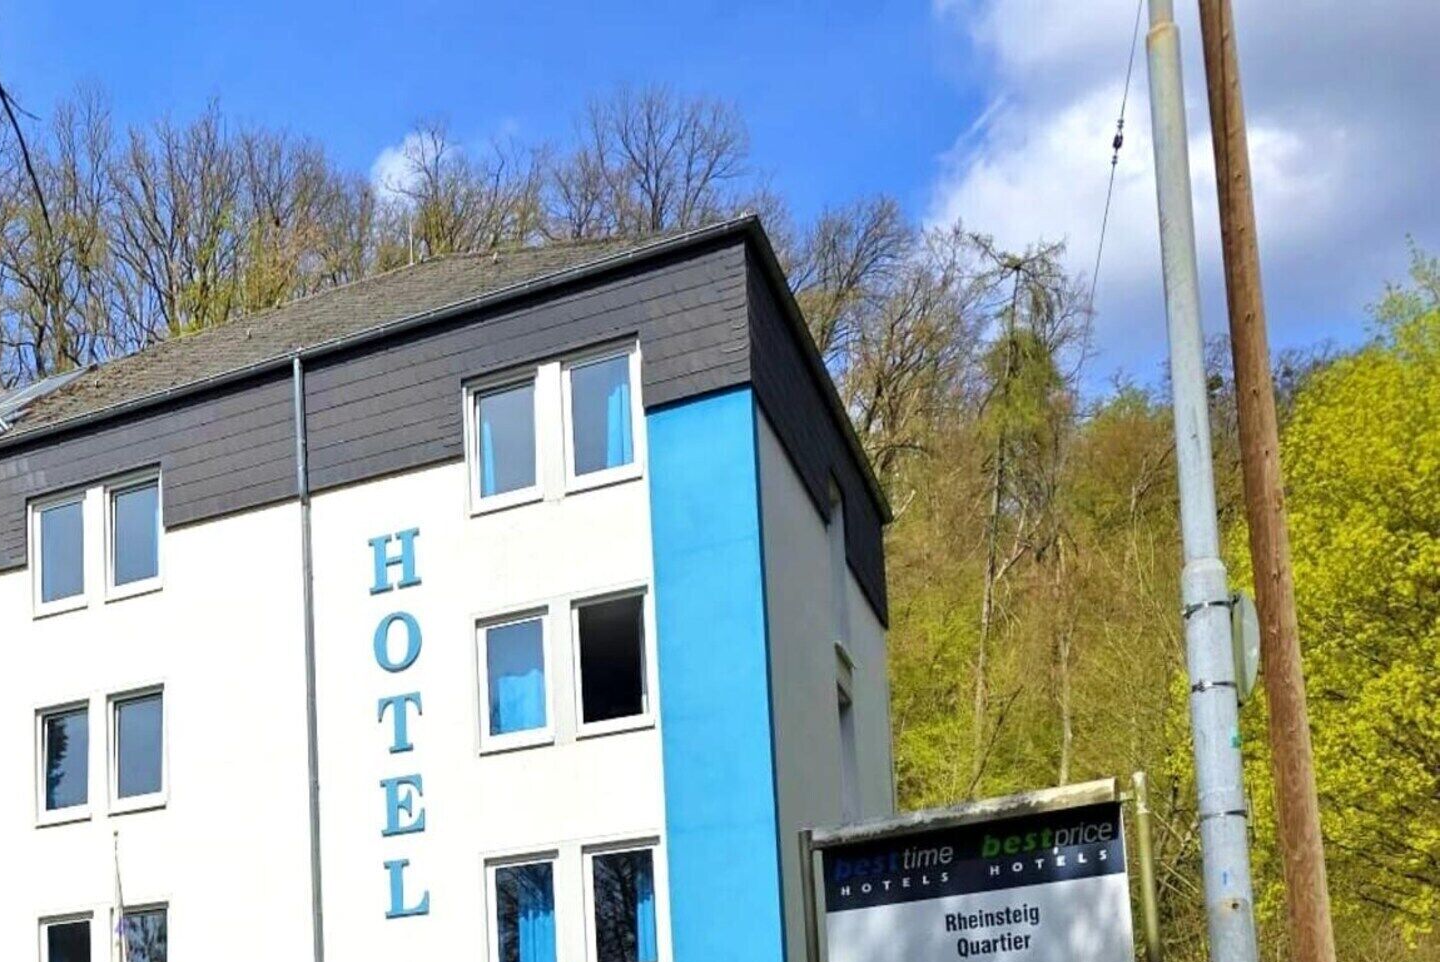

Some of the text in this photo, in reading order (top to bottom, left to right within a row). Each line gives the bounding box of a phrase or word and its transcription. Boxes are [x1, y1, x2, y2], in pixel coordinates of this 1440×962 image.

[368, 527, 429, 919] HOTEL
[990, 849, 1108, 876] HOTELS
[840, 872, 949, 897] HOTELS
[945, 903, 1040, 932] Rheinsteig
[957, 932, 1031, 958] Quartier
